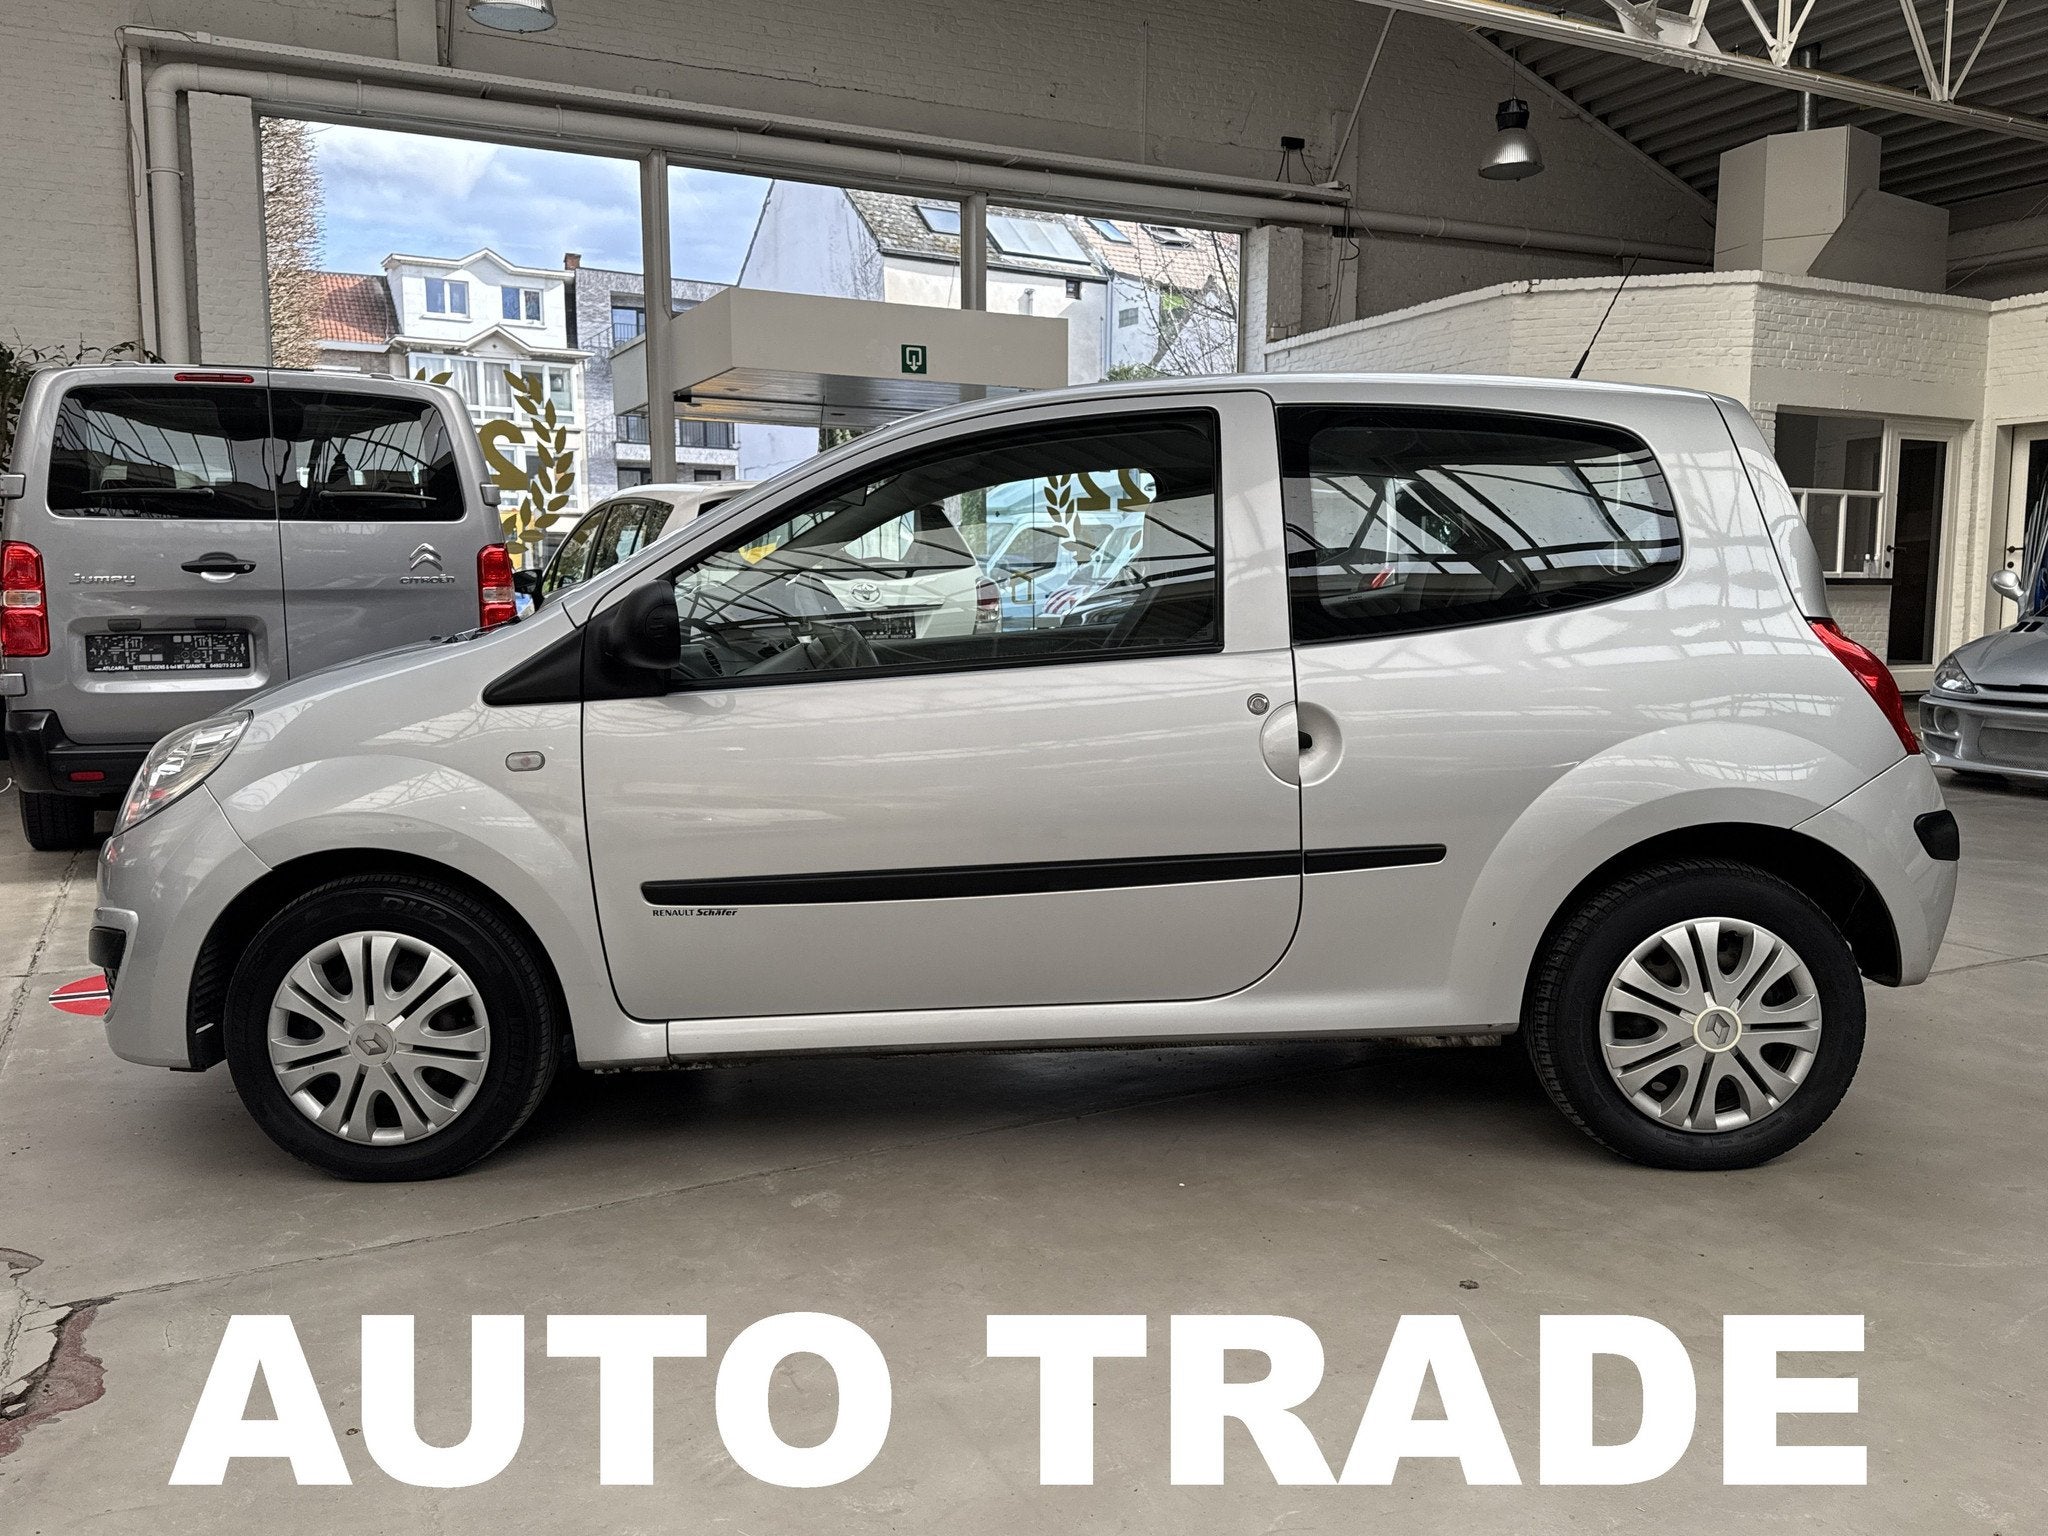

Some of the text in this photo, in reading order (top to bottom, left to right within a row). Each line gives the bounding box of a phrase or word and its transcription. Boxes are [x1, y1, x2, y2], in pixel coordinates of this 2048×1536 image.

[68, 572, 136, 587] Jumpy
[400, 573, 456, 585] CITROËN
[652, 908, 739, 917] RENAULT Schäfer
